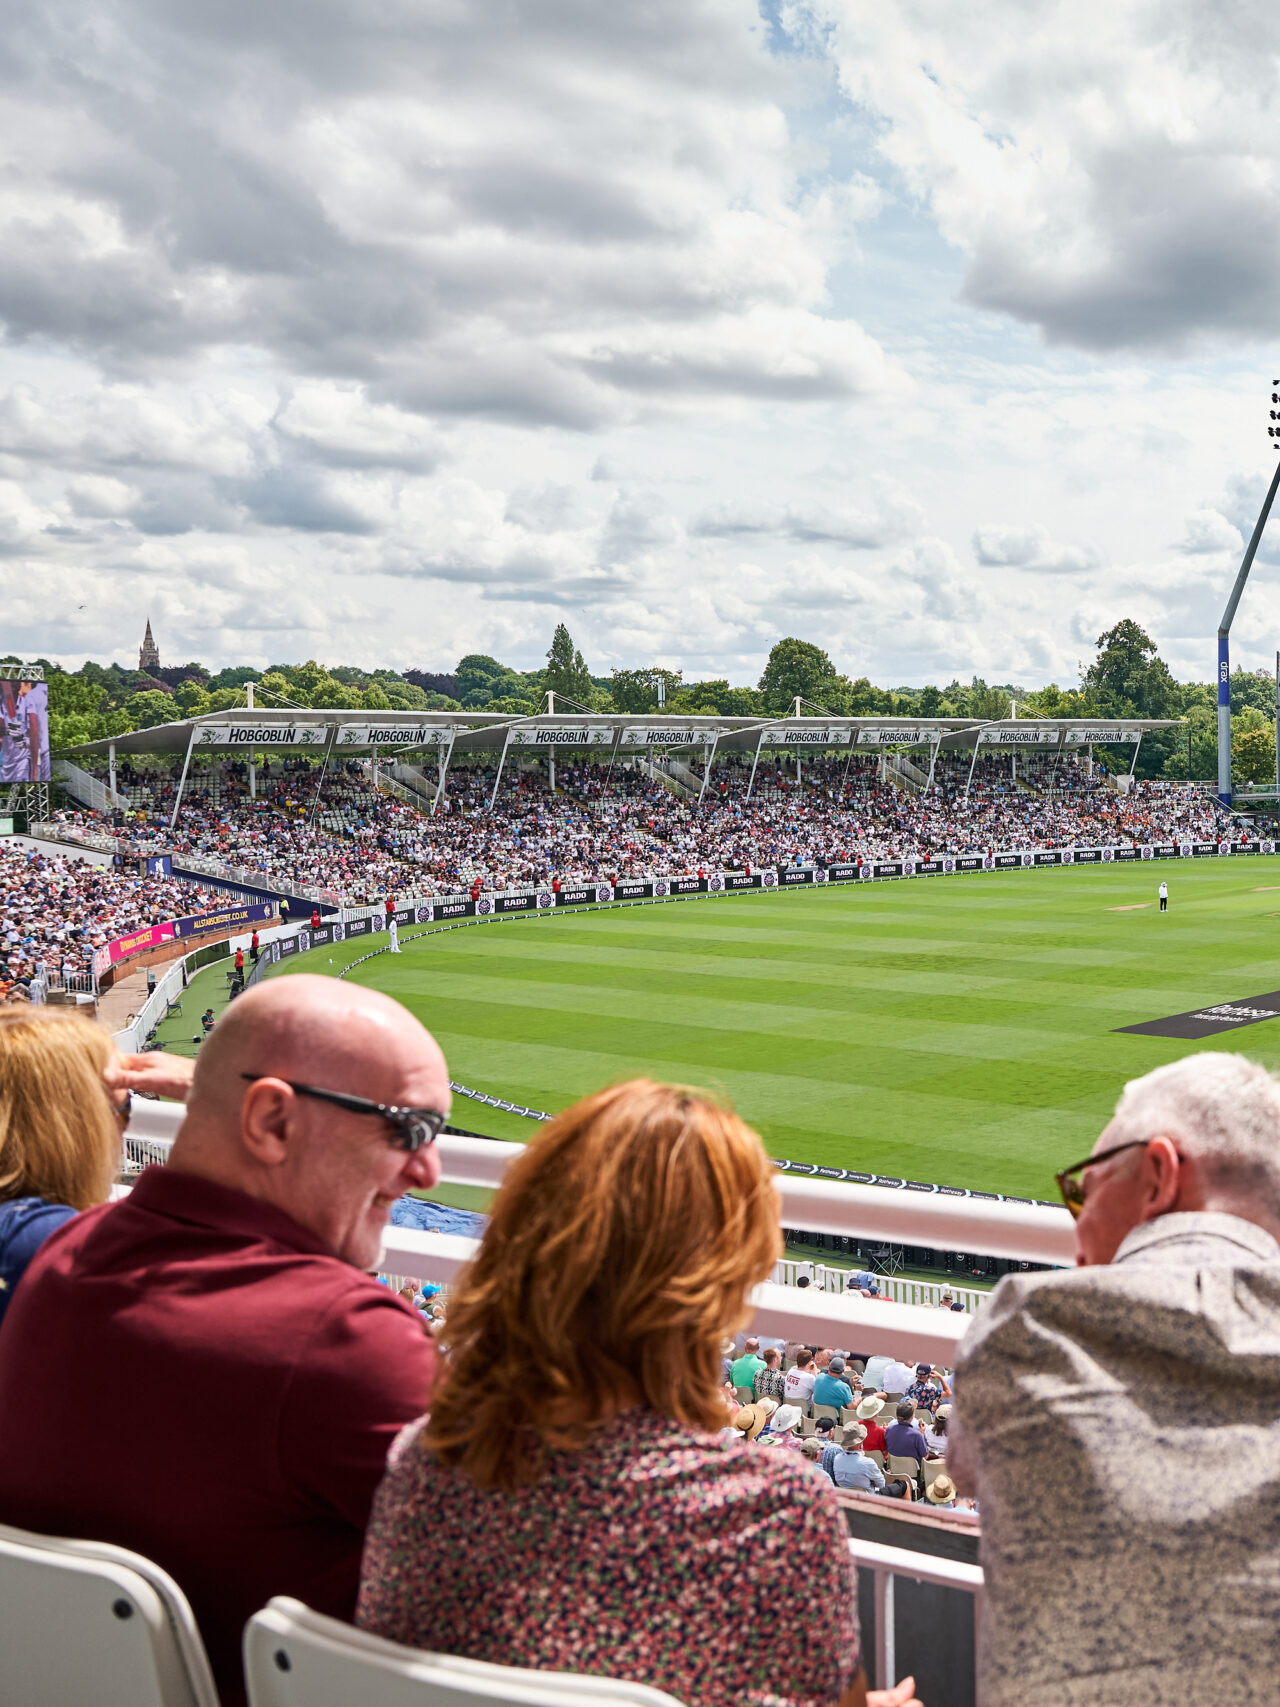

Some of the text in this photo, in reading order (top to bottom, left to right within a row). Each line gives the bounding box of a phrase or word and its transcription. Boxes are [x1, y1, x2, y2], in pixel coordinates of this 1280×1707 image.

[1220, 662, 1228, 683] drax
[229, 729, 296, 742] HOBGOBLIN
[368, 730, 426, 743] HOBGOBLIN
[536, 731, 589, 743] HOBGOBLIN
[646, 731, 694, 743] HOBGOBLIN
[785, 732, 830, 743] HOBGOBLIN
[879, 732, 920, 742] HOBGOBLIN
[1000, 732, 1039, 742] HOBGOBLIN
[1085, 732, 1122, 742] HOBGOBLIN
[786, 873, 805, 881] RADO
[836, 869, 854, 877] RADO
[678, 881, 699, 889] RADO
[732, 877, 753, 885] RADO
[623, 887, 644, 895] RADO
[564, 892, 587, 901] RADO
[504, 898, 527, 907] RADO
[443, 905, 465, 914] RADO
[350, 921, 365, 931] RADO
[314, 930, 328, 940] RADO
